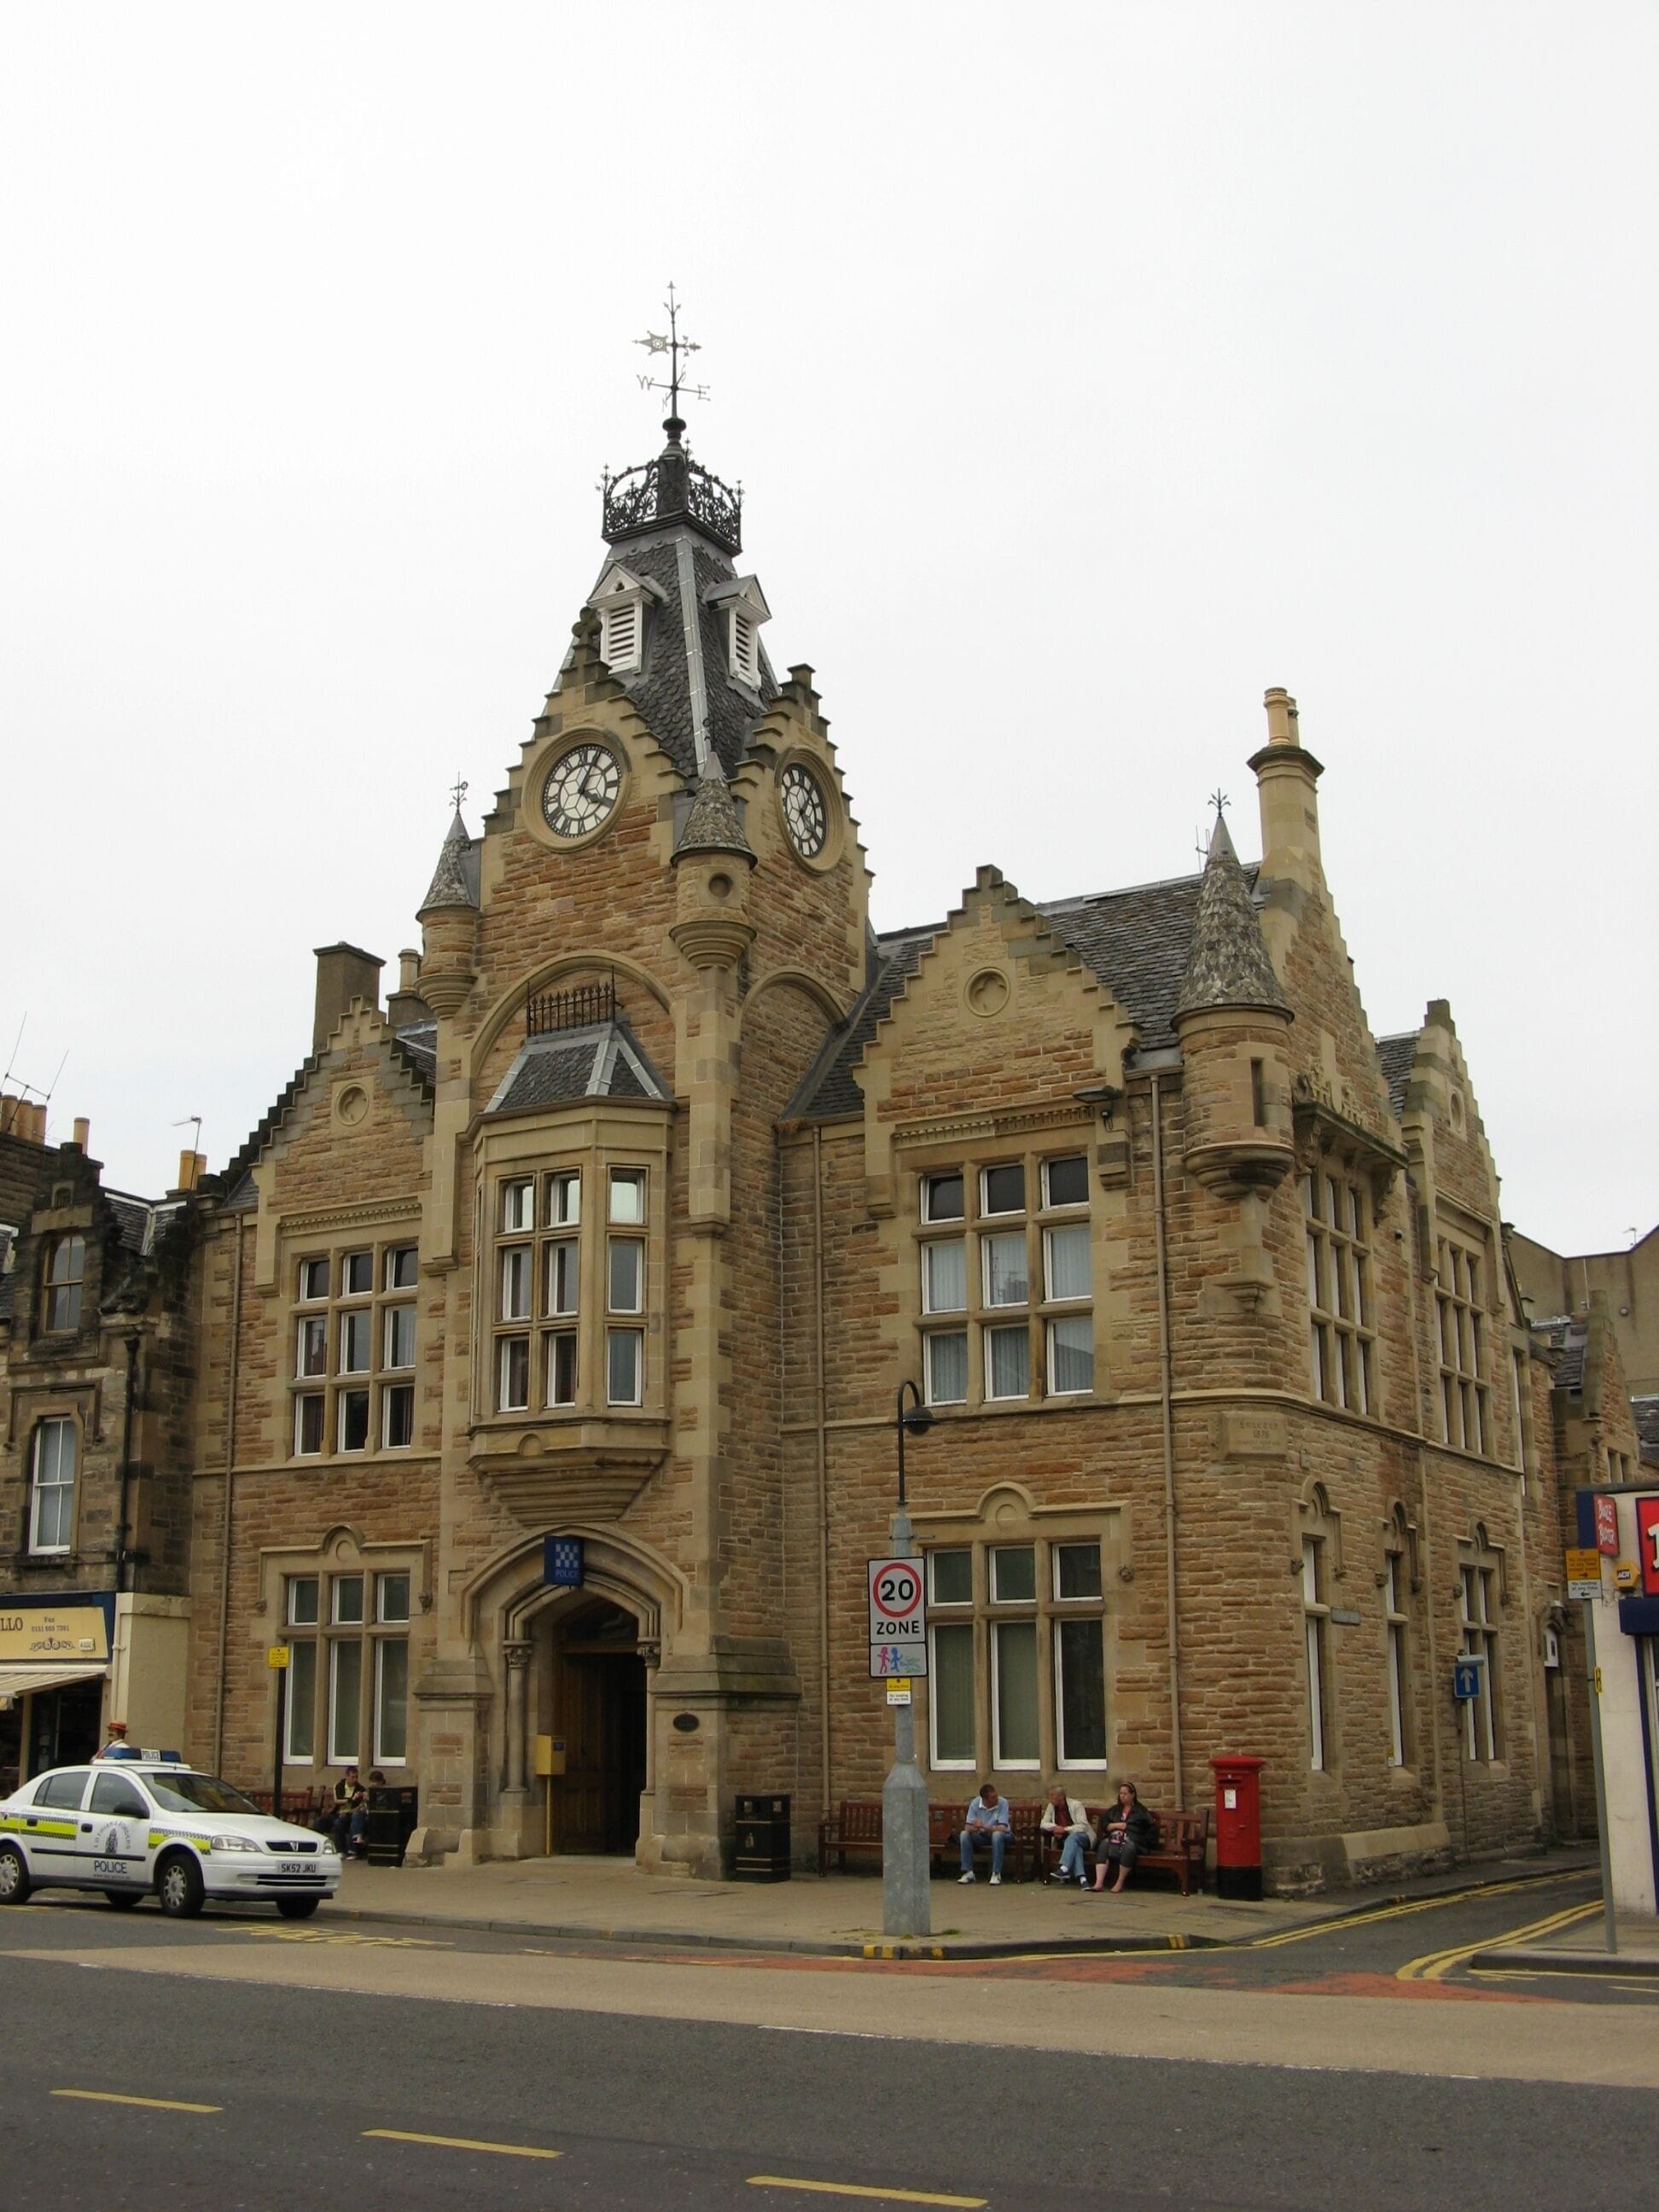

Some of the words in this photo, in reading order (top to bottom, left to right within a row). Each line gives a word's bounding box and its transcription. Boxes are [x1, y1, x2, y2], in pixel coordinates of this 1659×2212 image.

[556, 1569, 579, 1578] POLICE
[880, 1579, 914, 1601] 20
[876, 1621, 920, 1635] ZONE
[94, 1860, 127, 1874] POLICE
[281, 1863, 300, 1873] SK52
[302, 1863, 317, 1873] JKU
